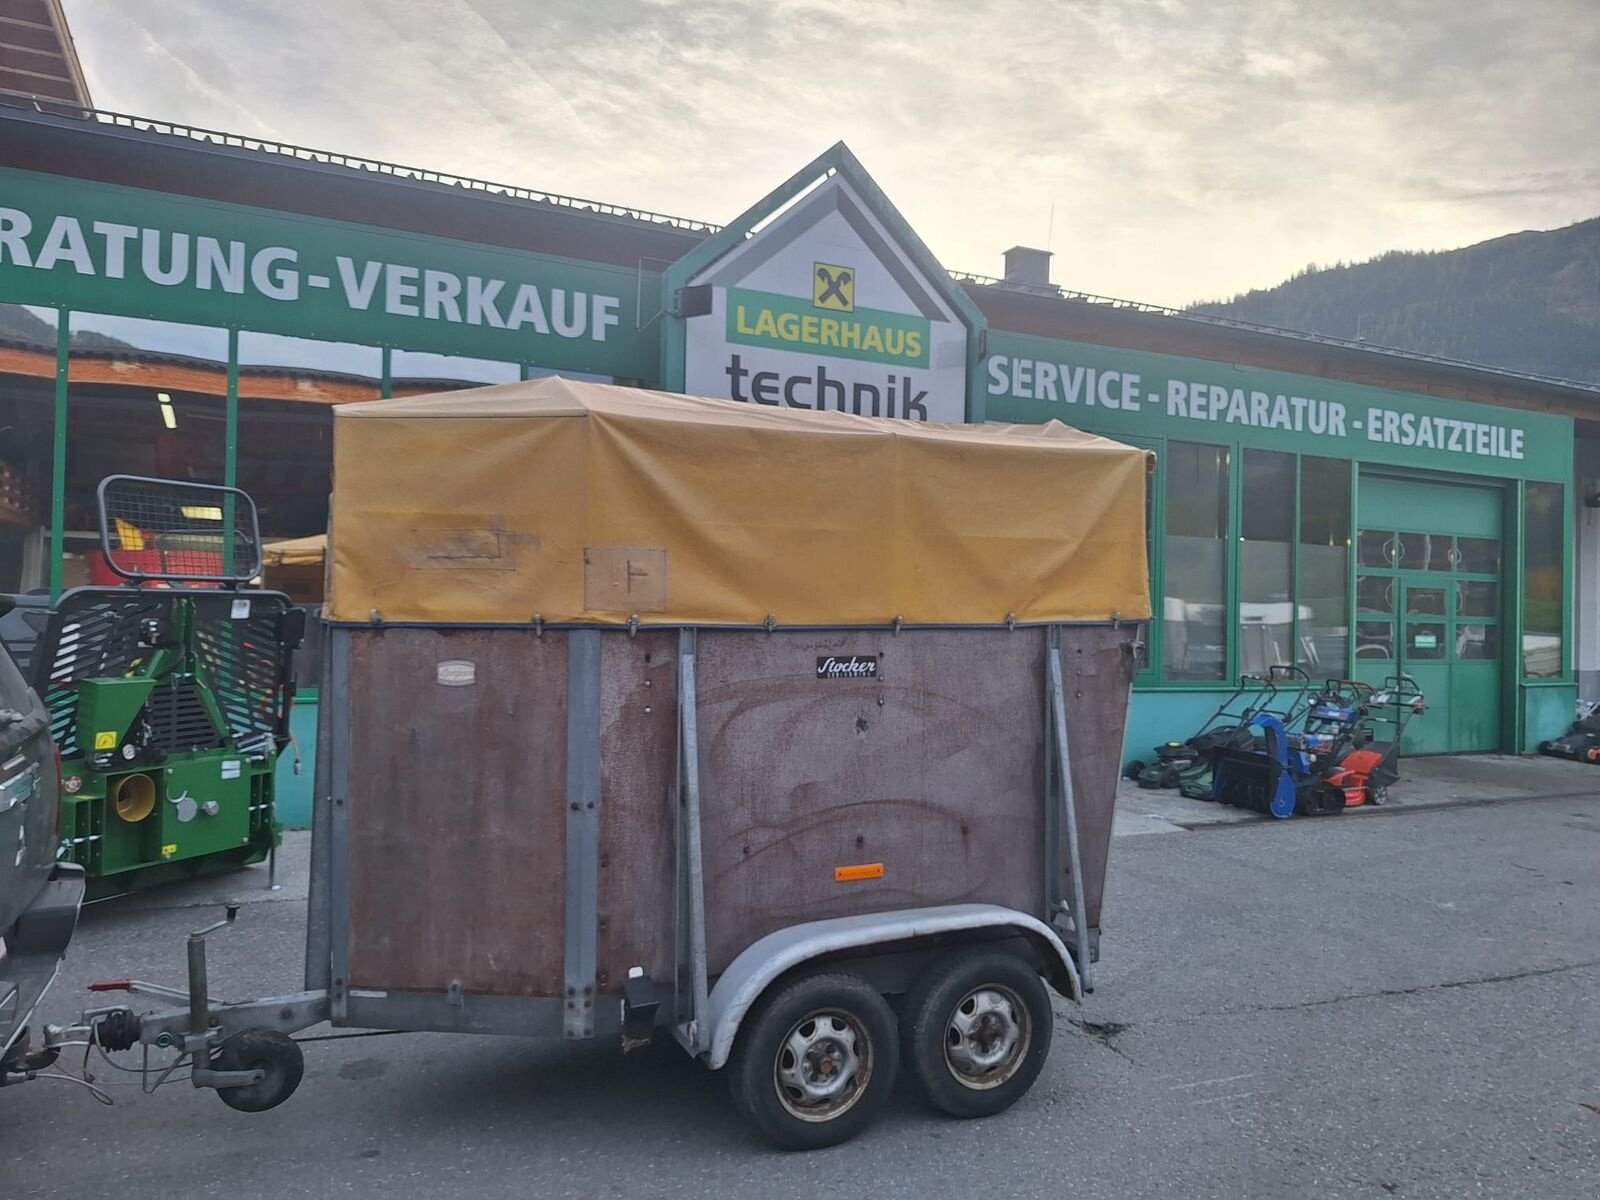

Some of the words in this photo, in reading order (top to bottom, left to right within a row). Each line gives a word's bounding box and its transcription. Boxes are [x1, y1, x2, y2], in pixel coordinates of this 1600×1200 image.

[736, 305, 922, 358] LAGERHAUS
[725, 353, 929, 422] technik
[987, 355, 1141, 412] SERVICE
[1167, 379, 1347, 437] REPARATUR
[1367, 407, 1525, 460] ERSATZTEILE
[817, 656, 876, 673] Stocker
